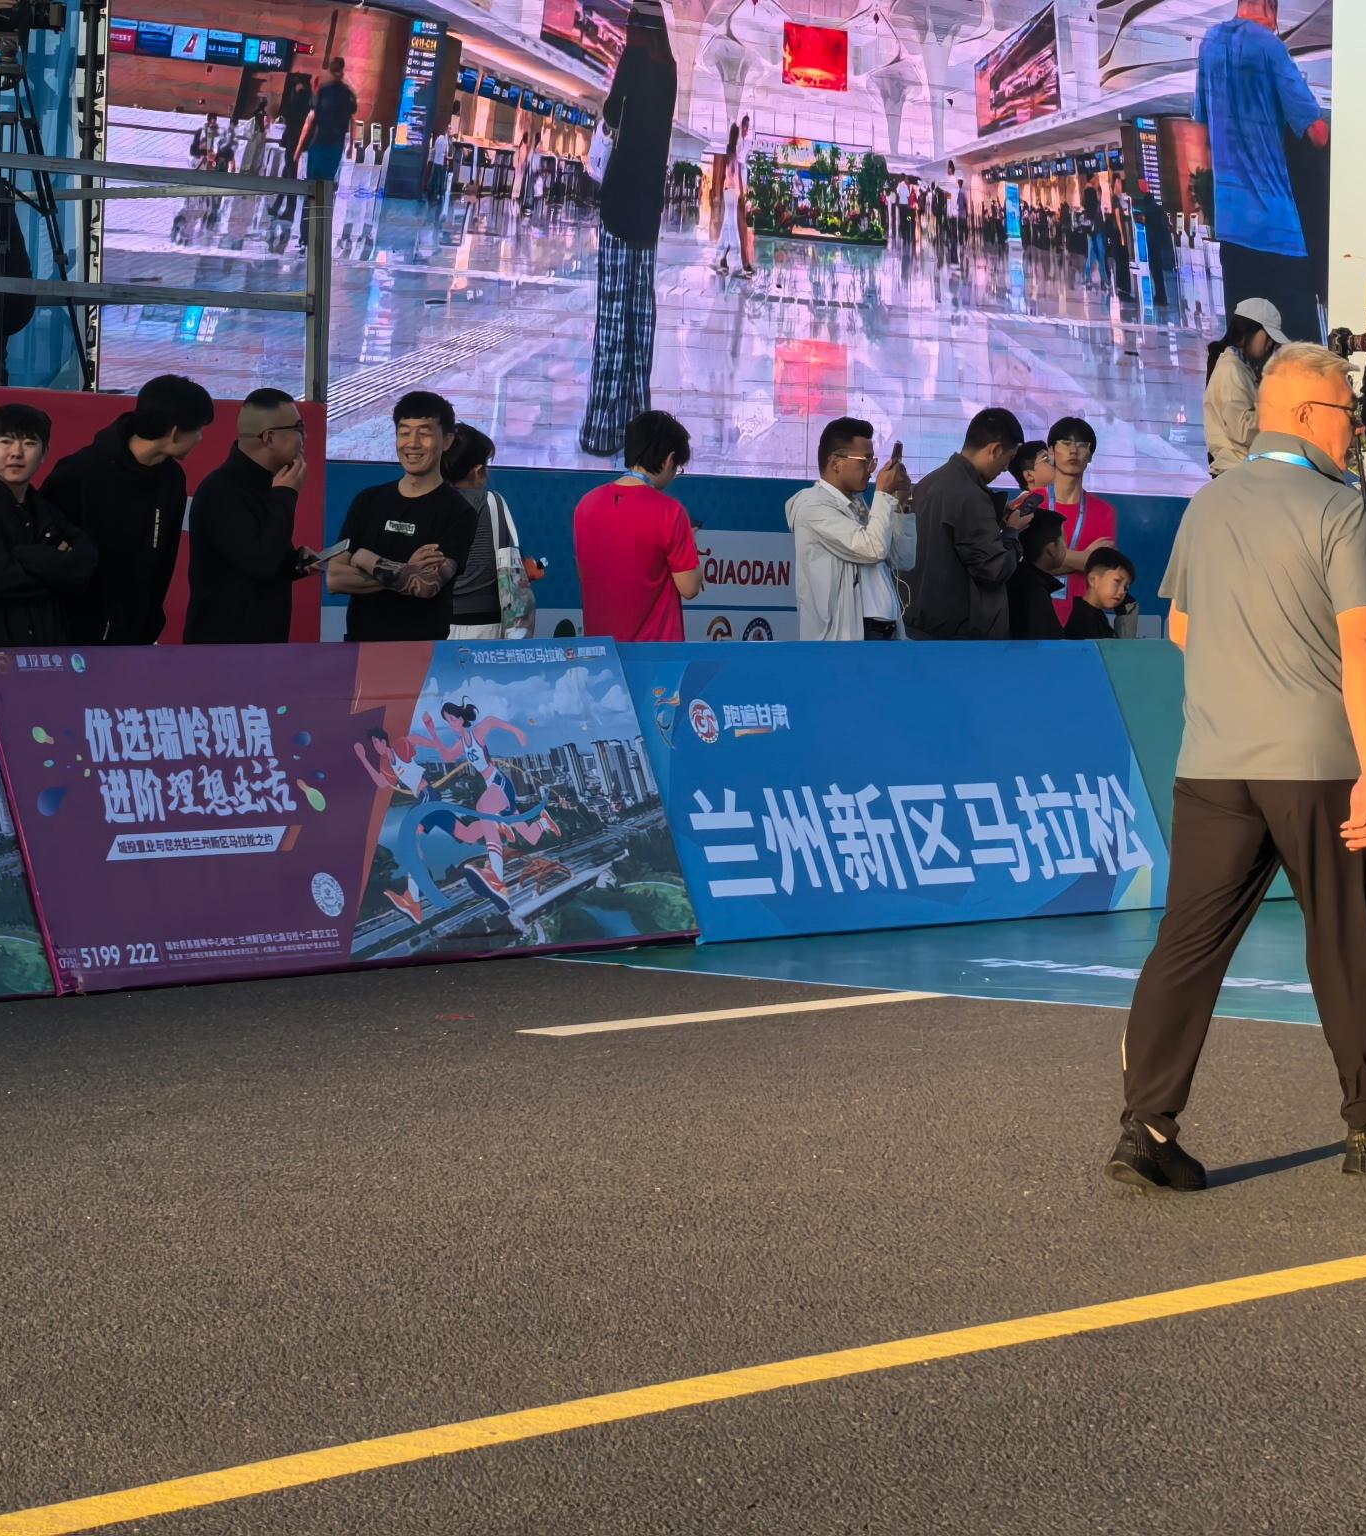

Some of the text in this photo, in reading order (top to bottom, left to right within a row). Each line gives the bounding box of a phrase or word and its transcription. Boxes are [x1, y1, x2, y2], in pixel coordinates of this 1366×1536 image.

[704, 558, 790, 586] QIAODAN
[85, 704, 274, 762] 优选瑞岭现房
[722, 704, 790, 732] 跑遍甘肃
[98, 758, 297, 823] 进阶理想生活
[689, 772, 1155, 898] 兰州新区马拉松
[81, 945, 120, 968] 5199
[126, 943, 159, 964] 222
